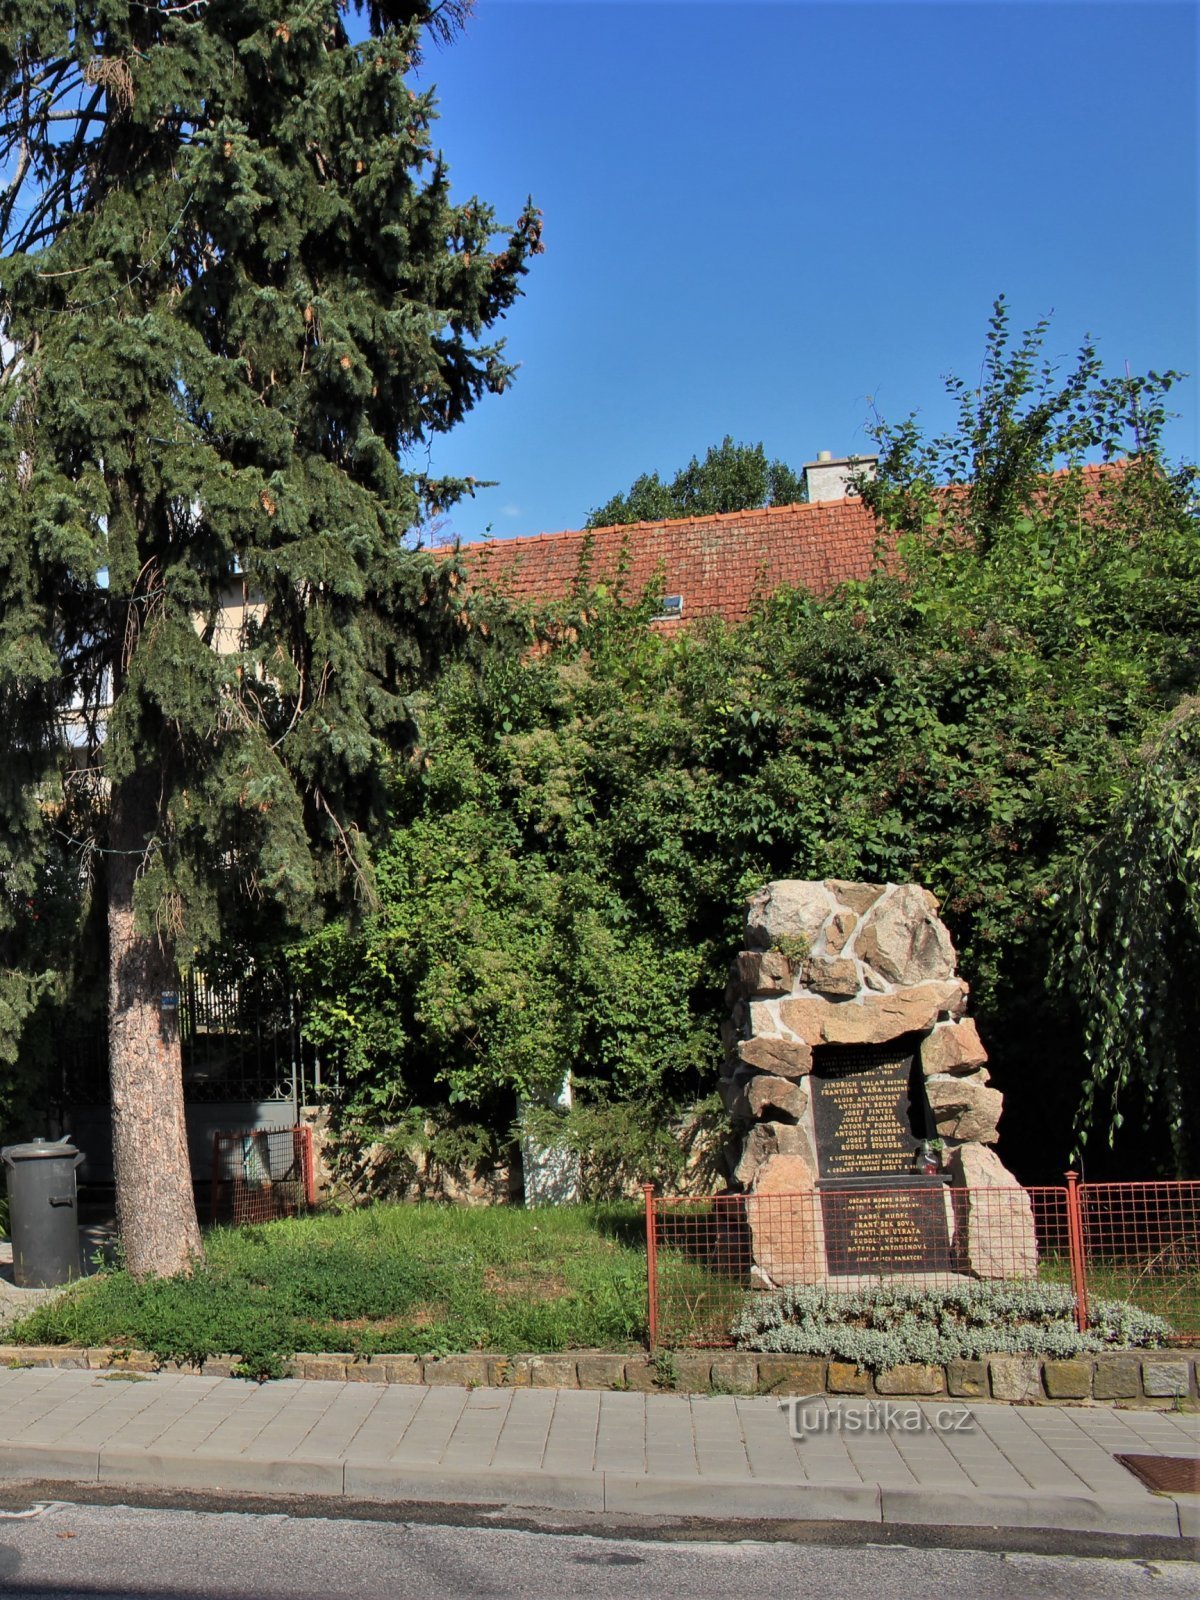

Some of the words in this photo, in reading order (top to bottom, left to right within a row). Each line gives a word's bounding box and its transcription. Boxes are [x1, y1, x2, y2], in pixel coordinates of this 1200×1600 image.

[824, 1081, 857, 1089] JINDŘICH
[821, 1088, 858, 1096] FRANTIŠEK
[857, 1094, 901, 1102] ANTOŠOVSKÝ
[838, 1102, 870, 1110] ANTONÍN
[866, 1114, 896, 1122] KOLAŘÍK
[838, 1122, 870, 1130] ANTONÍN
[835, 1129, 866, 1137] ANTONÍN
[841, 1143, 868, 1151] RUDOLF
